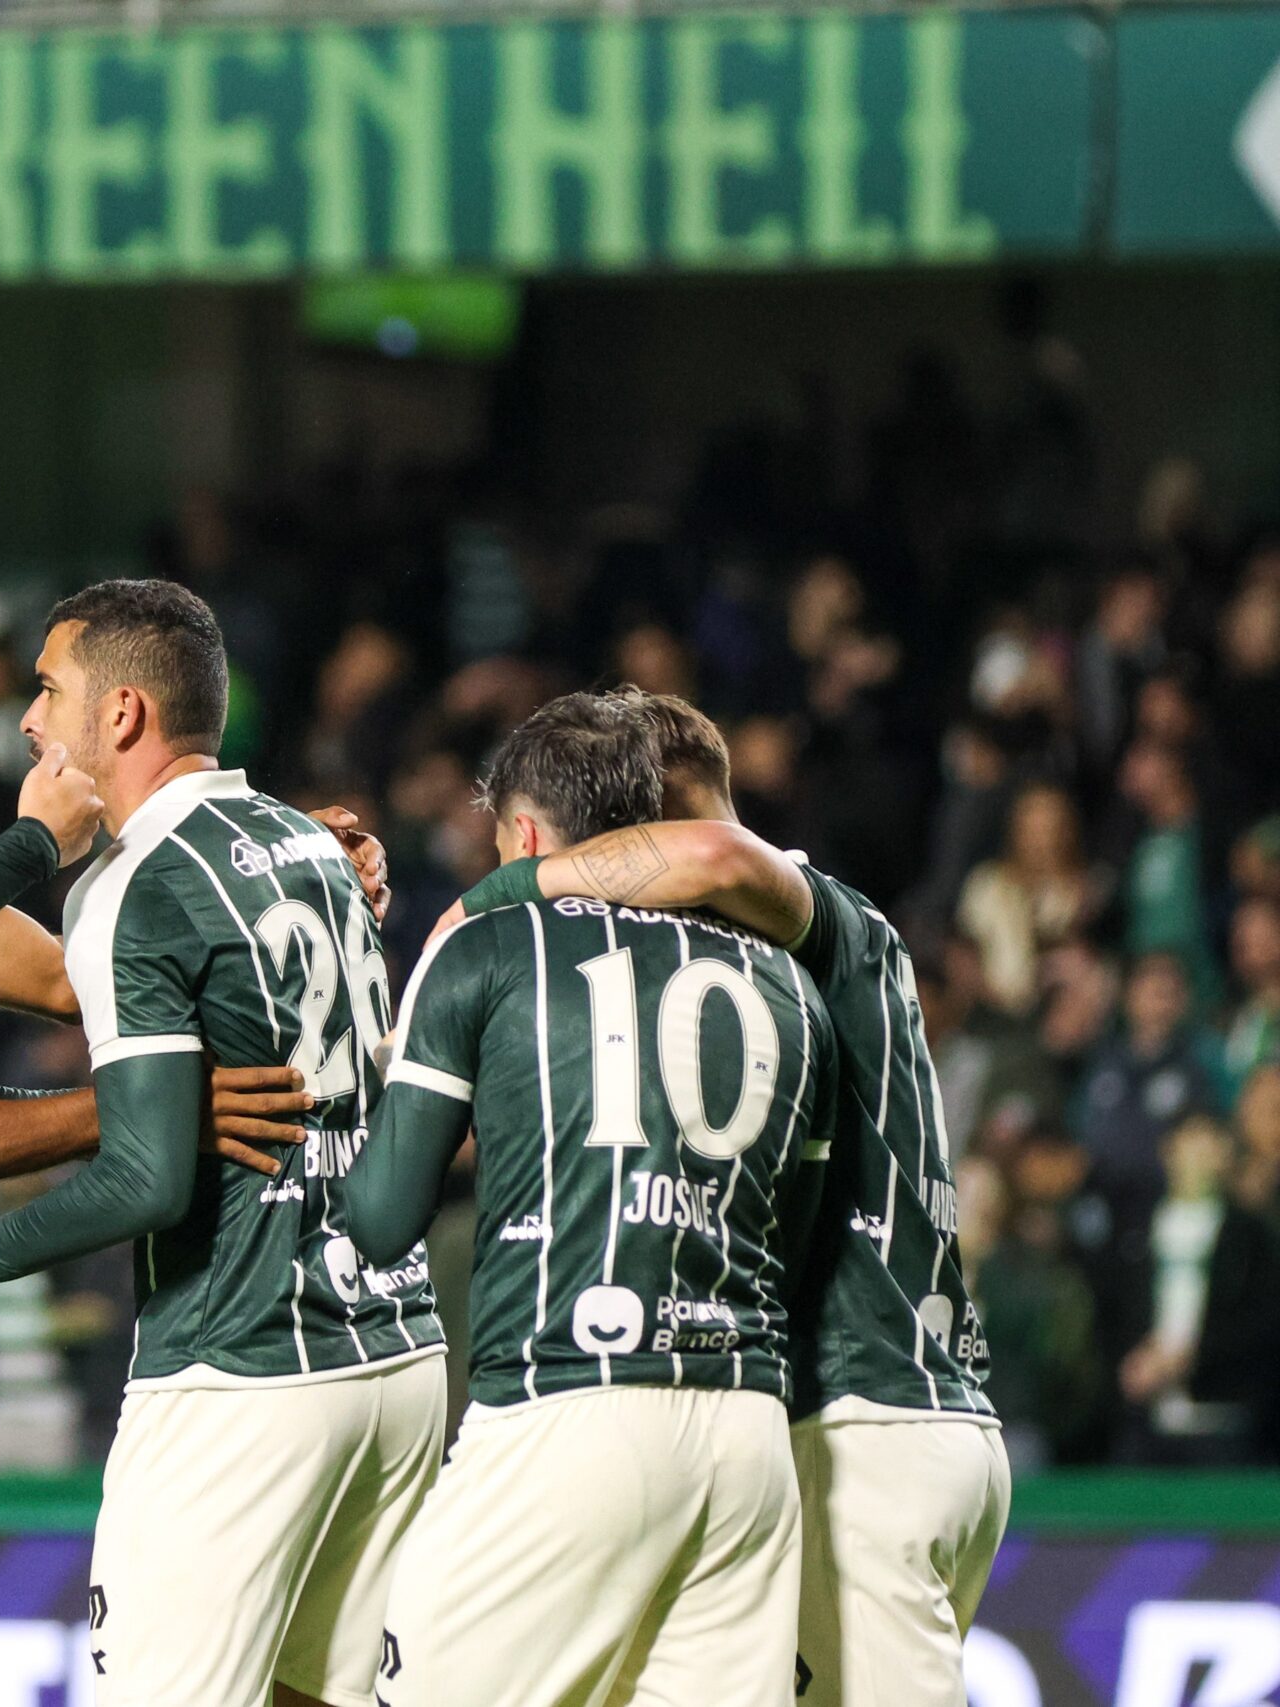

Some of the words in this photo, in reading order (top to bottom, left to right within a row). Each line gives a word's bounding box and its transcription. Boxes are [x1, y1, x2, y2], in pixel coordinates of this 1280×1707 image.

[489, 11, 998, 271] HELL
[254, 886, 393, 1101] 26
[575, 947, 779, 1160] 10
[606, 1034, 625, 1043] JFK
[754, 1060, 769, 1073] JFK
[624, 1170, 717, 1236] JOSUÉ
[652, 1329, 740, 1352] Banco
